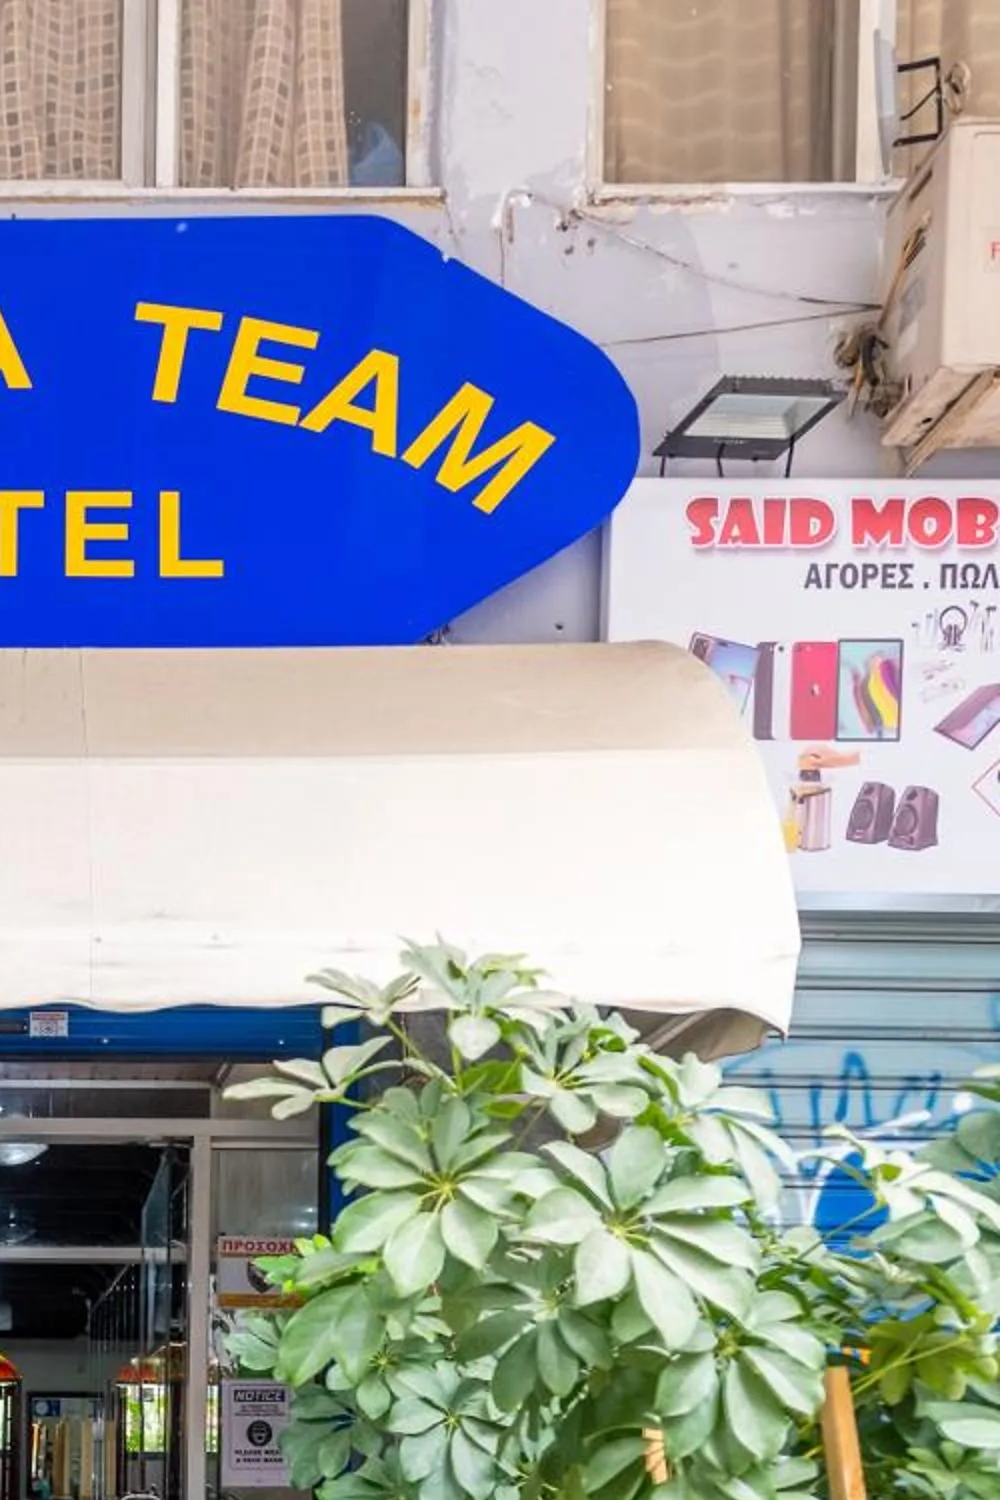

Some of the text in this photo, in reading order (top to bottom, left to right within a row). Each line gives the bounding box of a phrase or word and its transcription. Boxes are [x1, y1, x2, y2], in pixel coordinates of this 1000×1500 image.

[135, 303, 554, 513] TEAM
[686, 496, 1000, 546] SAID MOB
[804, 563, 914, 589] ΑΓΟΡΕΣ
[940, 563, 999, 589] ΠΩΛ
[234, 1390, 284, 1402] NOTICE
